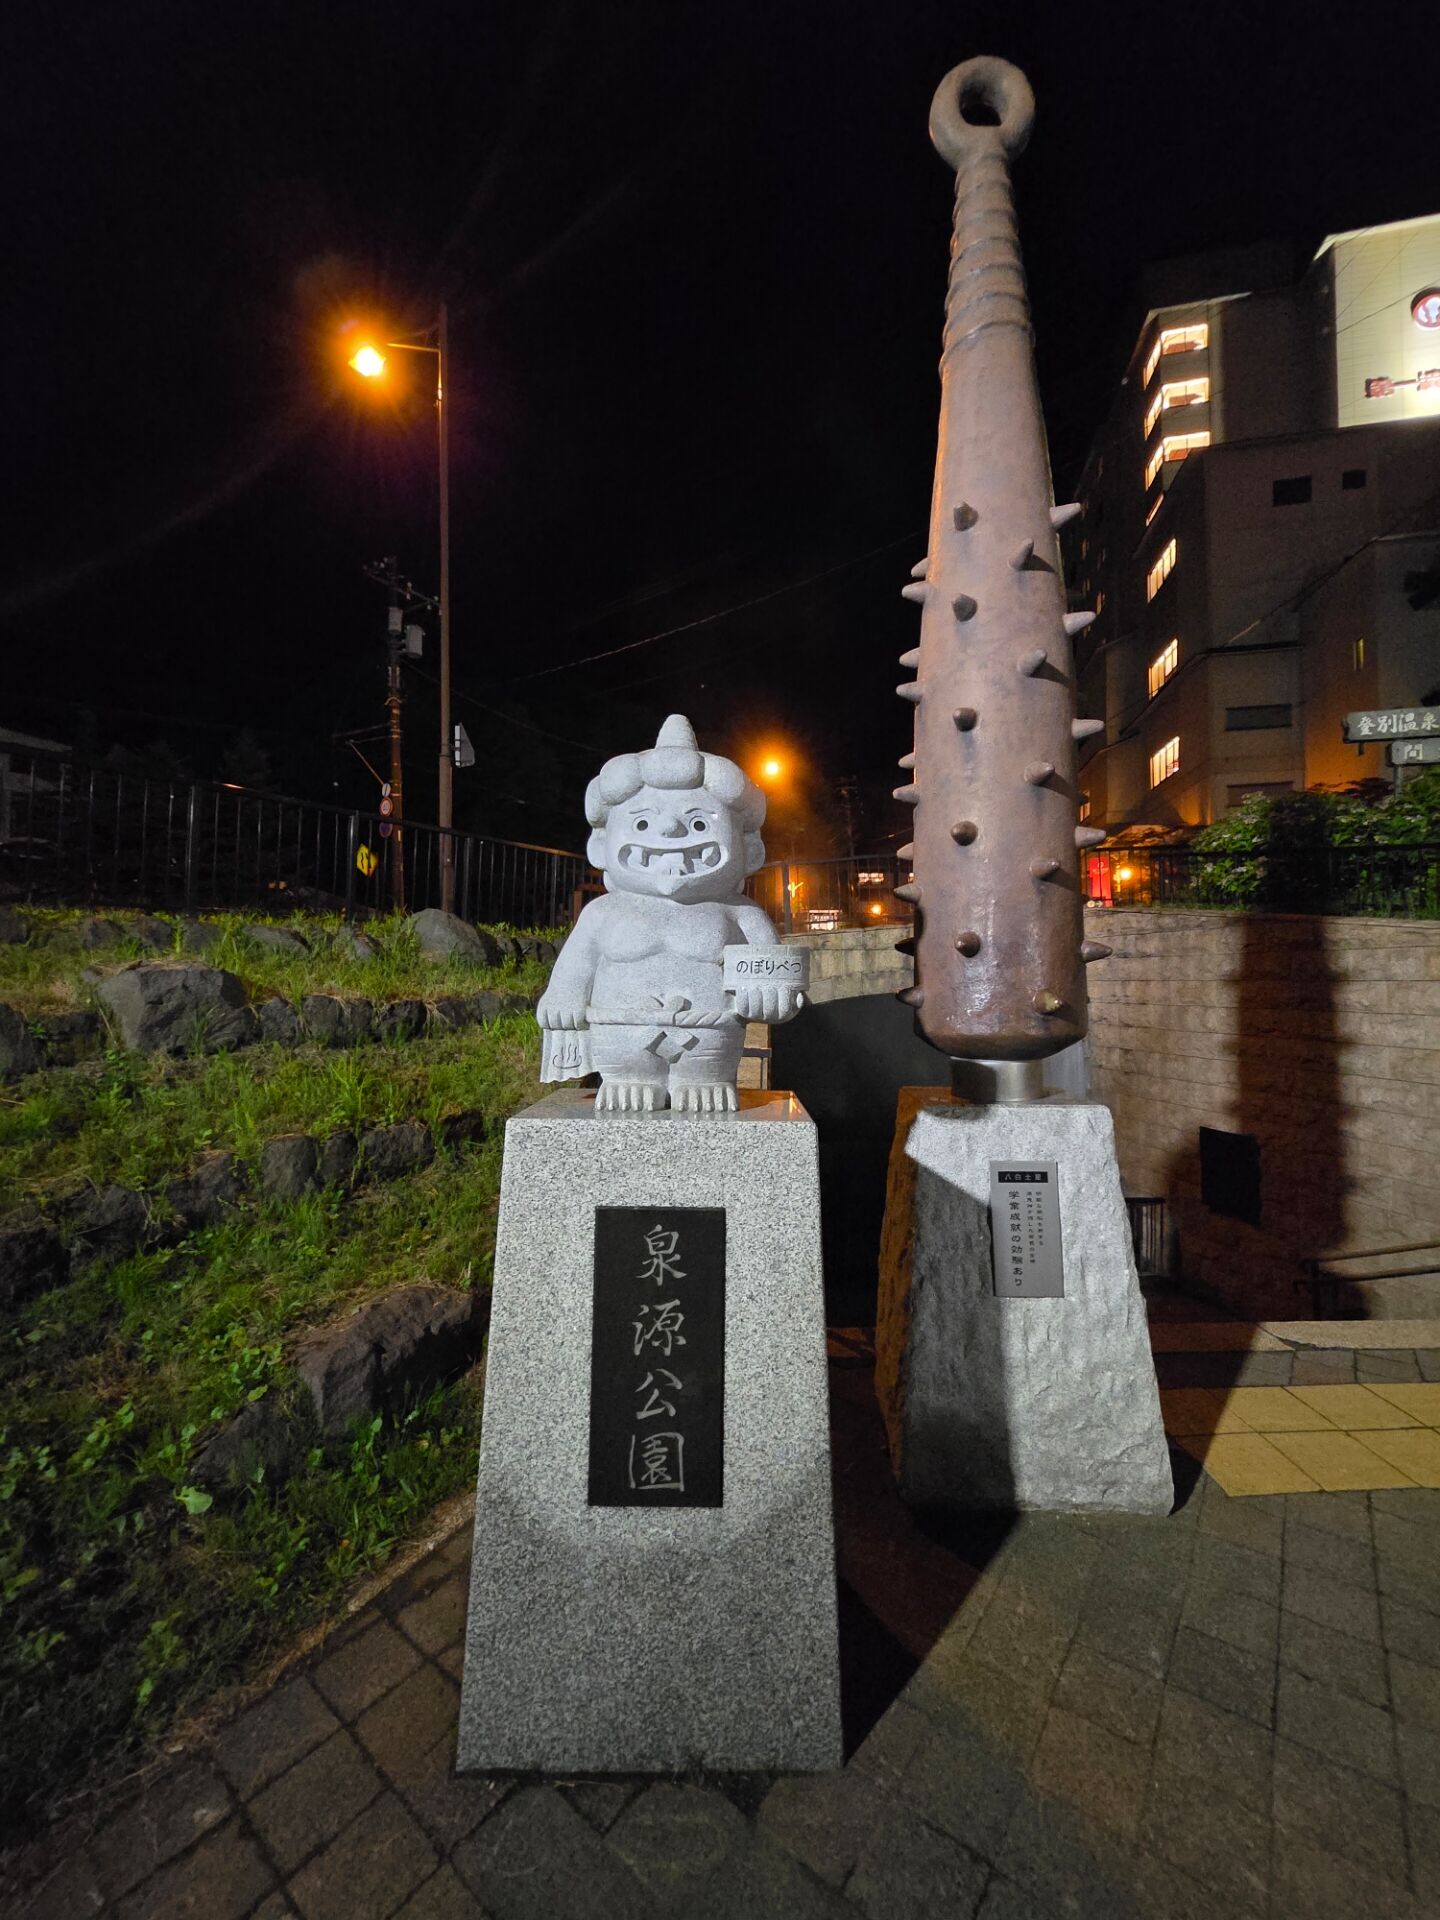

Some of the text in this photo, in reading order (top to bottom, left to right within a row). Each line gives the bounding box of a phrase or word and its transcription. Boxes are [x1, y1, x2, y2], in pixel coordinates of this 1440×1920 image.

[1357, 712, 1440, 735] 登別温泉
[736, 959, 802, 975] のぼりべつ
[629, 1223, 688, 1492] 泉源公園
